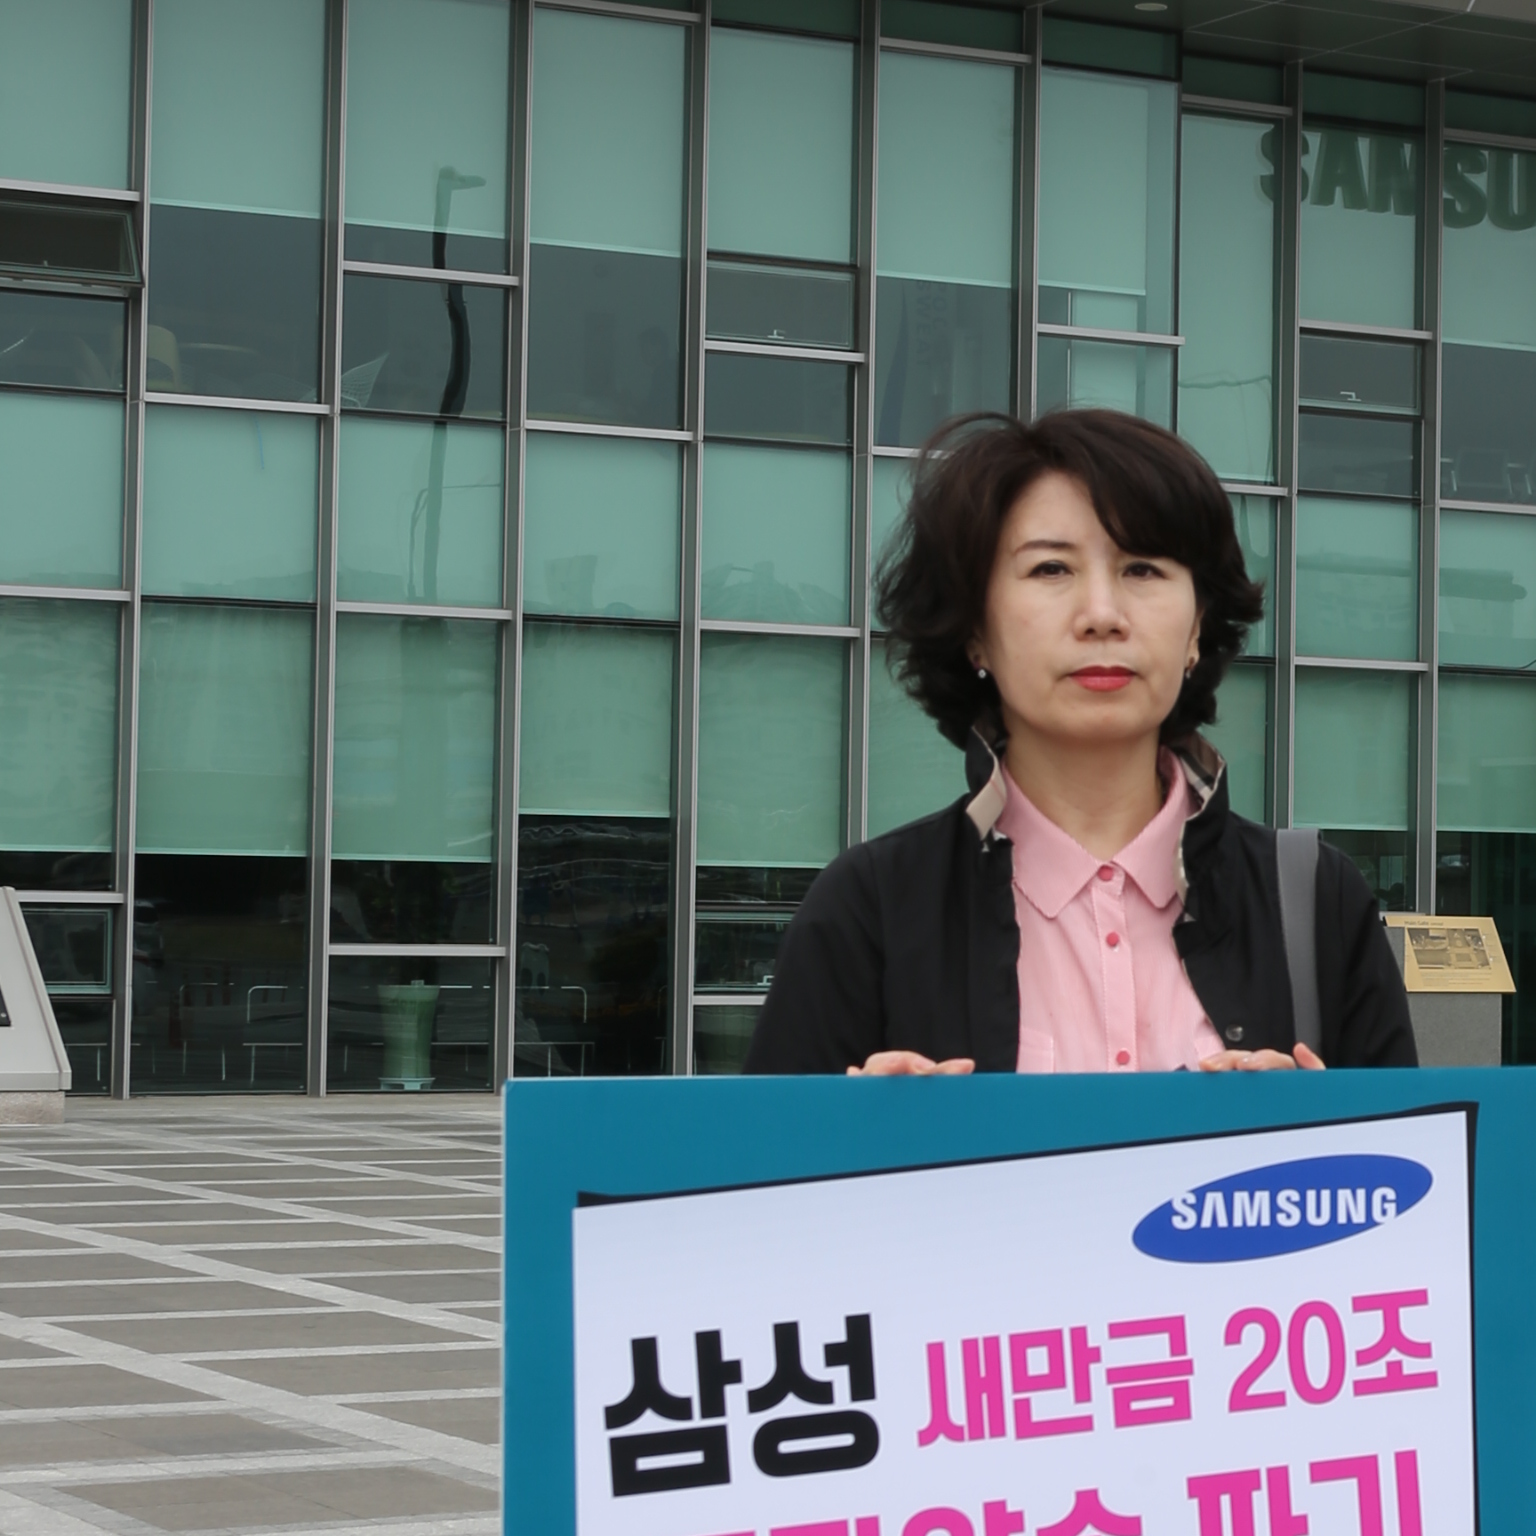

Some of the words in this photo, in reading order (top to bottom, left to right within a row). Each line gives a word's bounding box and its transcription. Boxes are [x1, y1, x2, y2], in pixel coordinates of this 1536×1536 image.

[1170, 1185, 1398, 1230] SAMSUNG
[602, 1312, 881, 1497] 삼성
[917, 1314, 1196, 1448] 새만금
[1222, 1288, 1439, 1414] 20조
